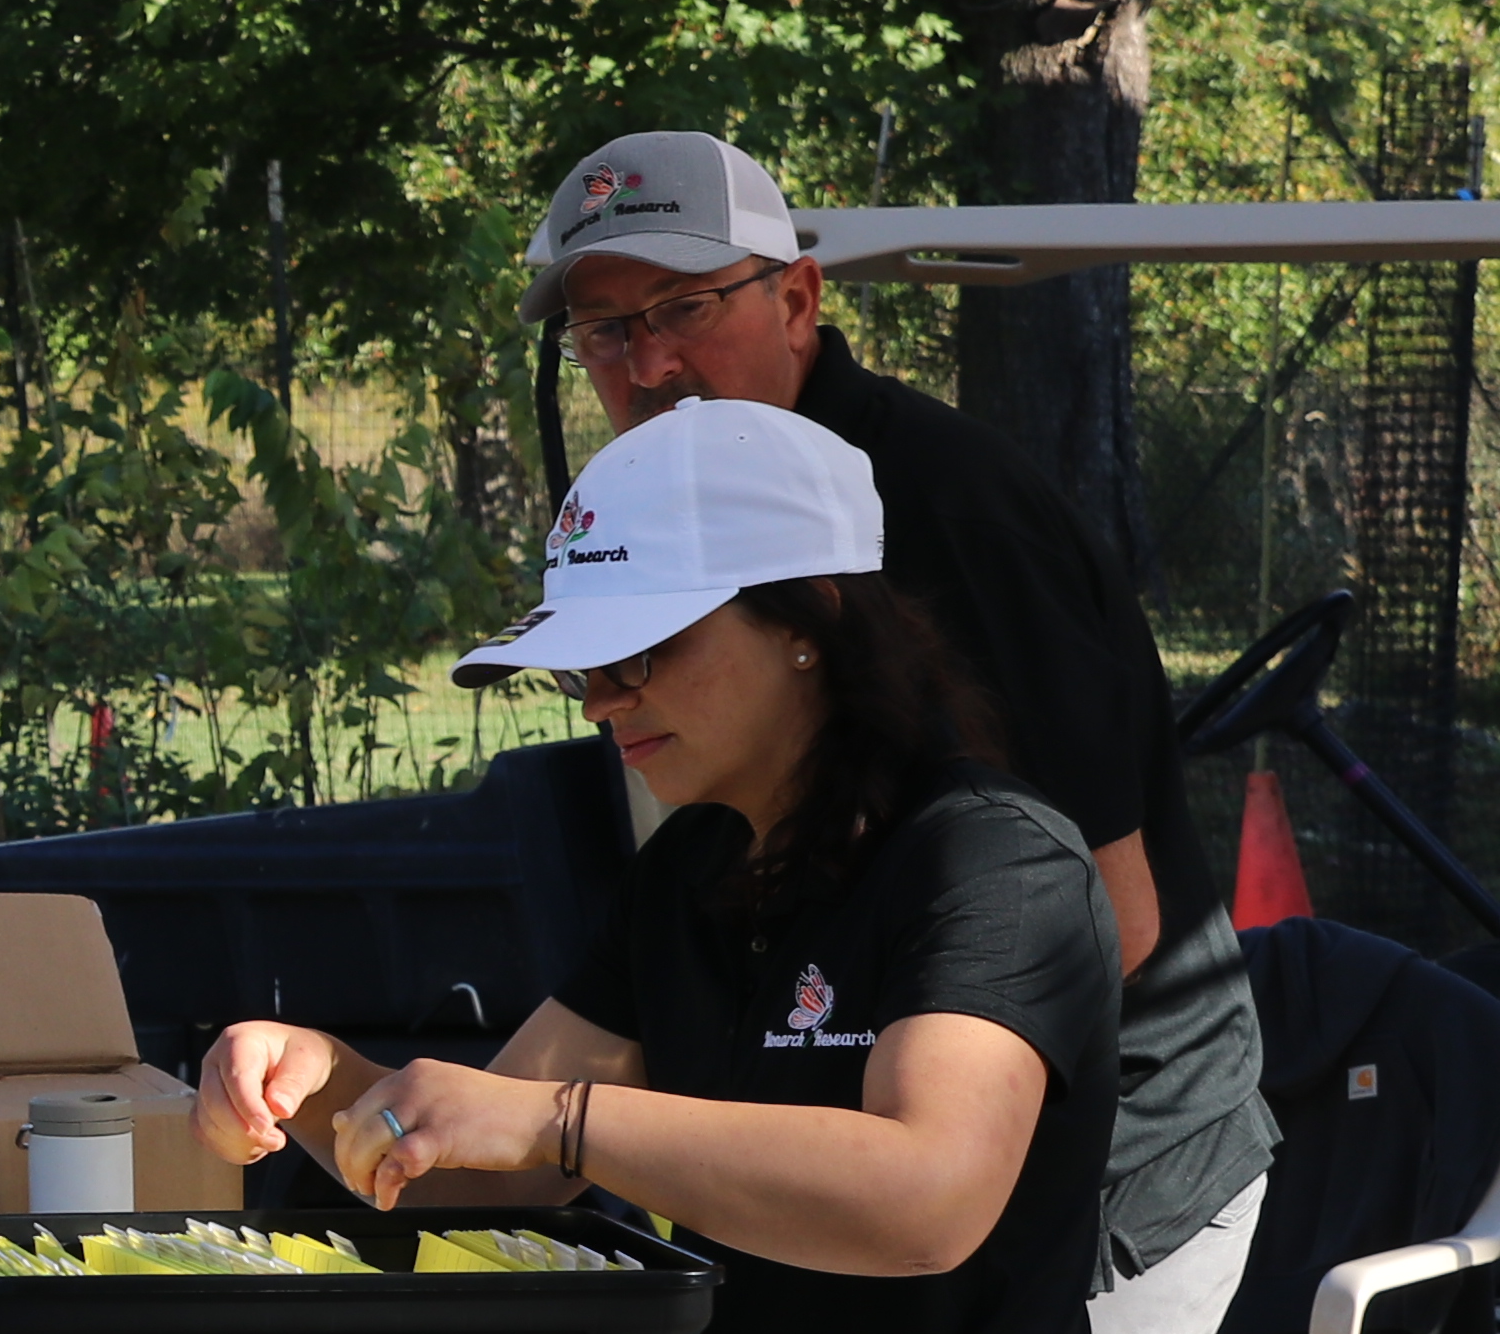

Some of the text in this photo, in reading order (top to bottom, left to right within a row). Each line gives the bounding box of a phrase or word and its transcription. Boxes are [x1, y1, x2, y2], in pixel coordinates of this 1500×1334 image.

[613, 200, 681, 216] Research
[567, 545, 629, 566] Research
[812, 1029, 877, 1047] Research
